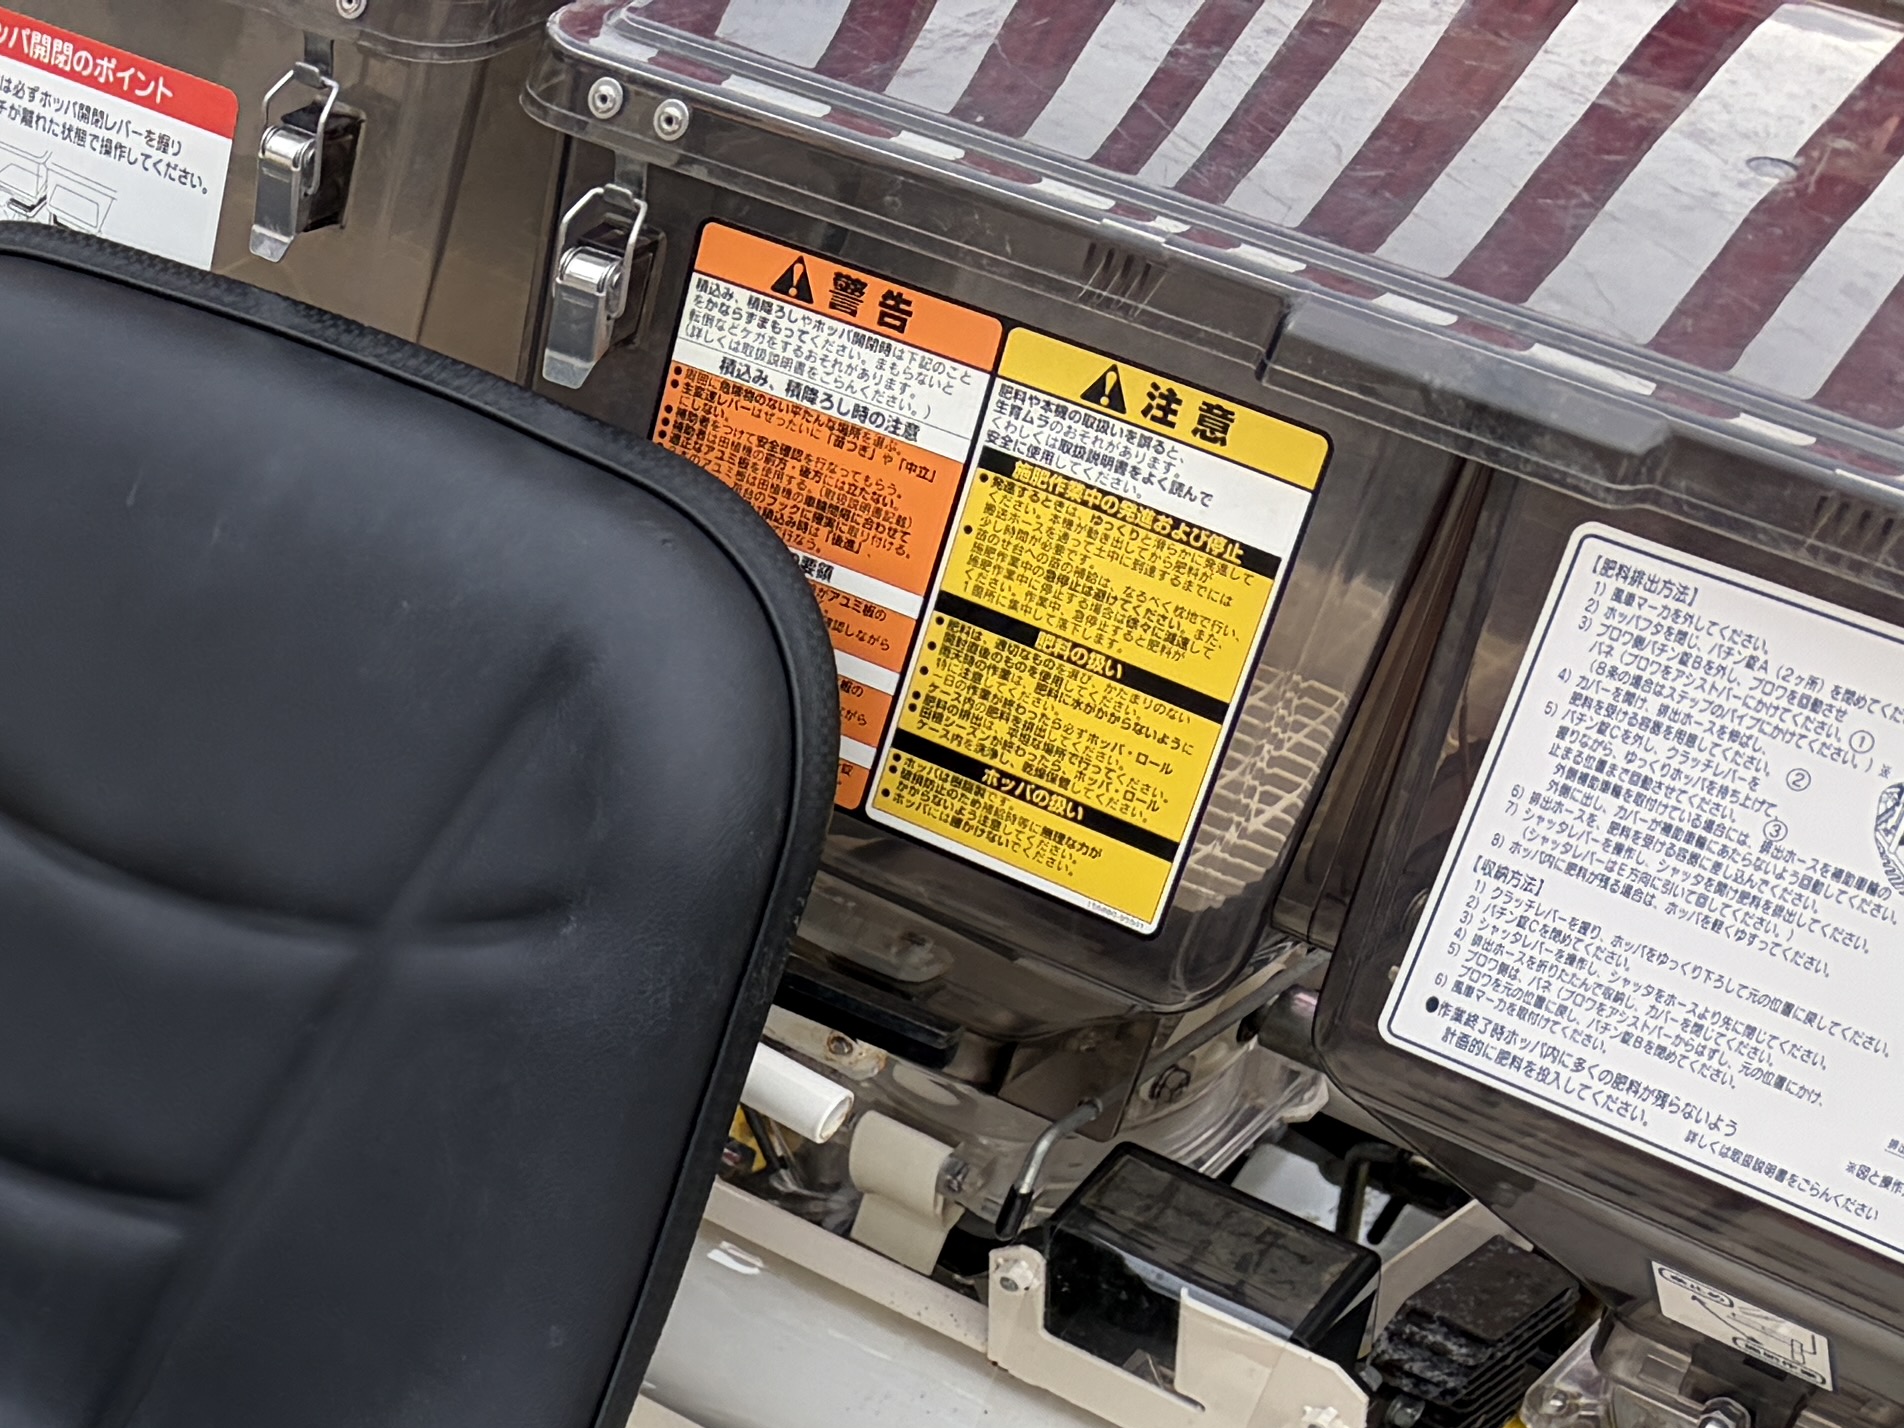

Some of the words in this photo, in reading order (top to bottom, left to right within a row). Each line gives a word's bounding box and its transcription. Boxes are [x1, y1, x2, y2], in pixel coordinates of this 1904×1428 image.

[824, 270, 917, 336] 警告
[717, 353, 921, 444] 積込み、積降ろし時の注意
[1139, 380, 1239, 448] 注意
[1589, 553, 1701, 608] 【肥料排出方法】
[1034, 630, 1126, 681] 肥料の扱い
[981, 765, 1086, 823] ホッパの扱い
[1469, 852, 1546, 898] 【収納方法】
